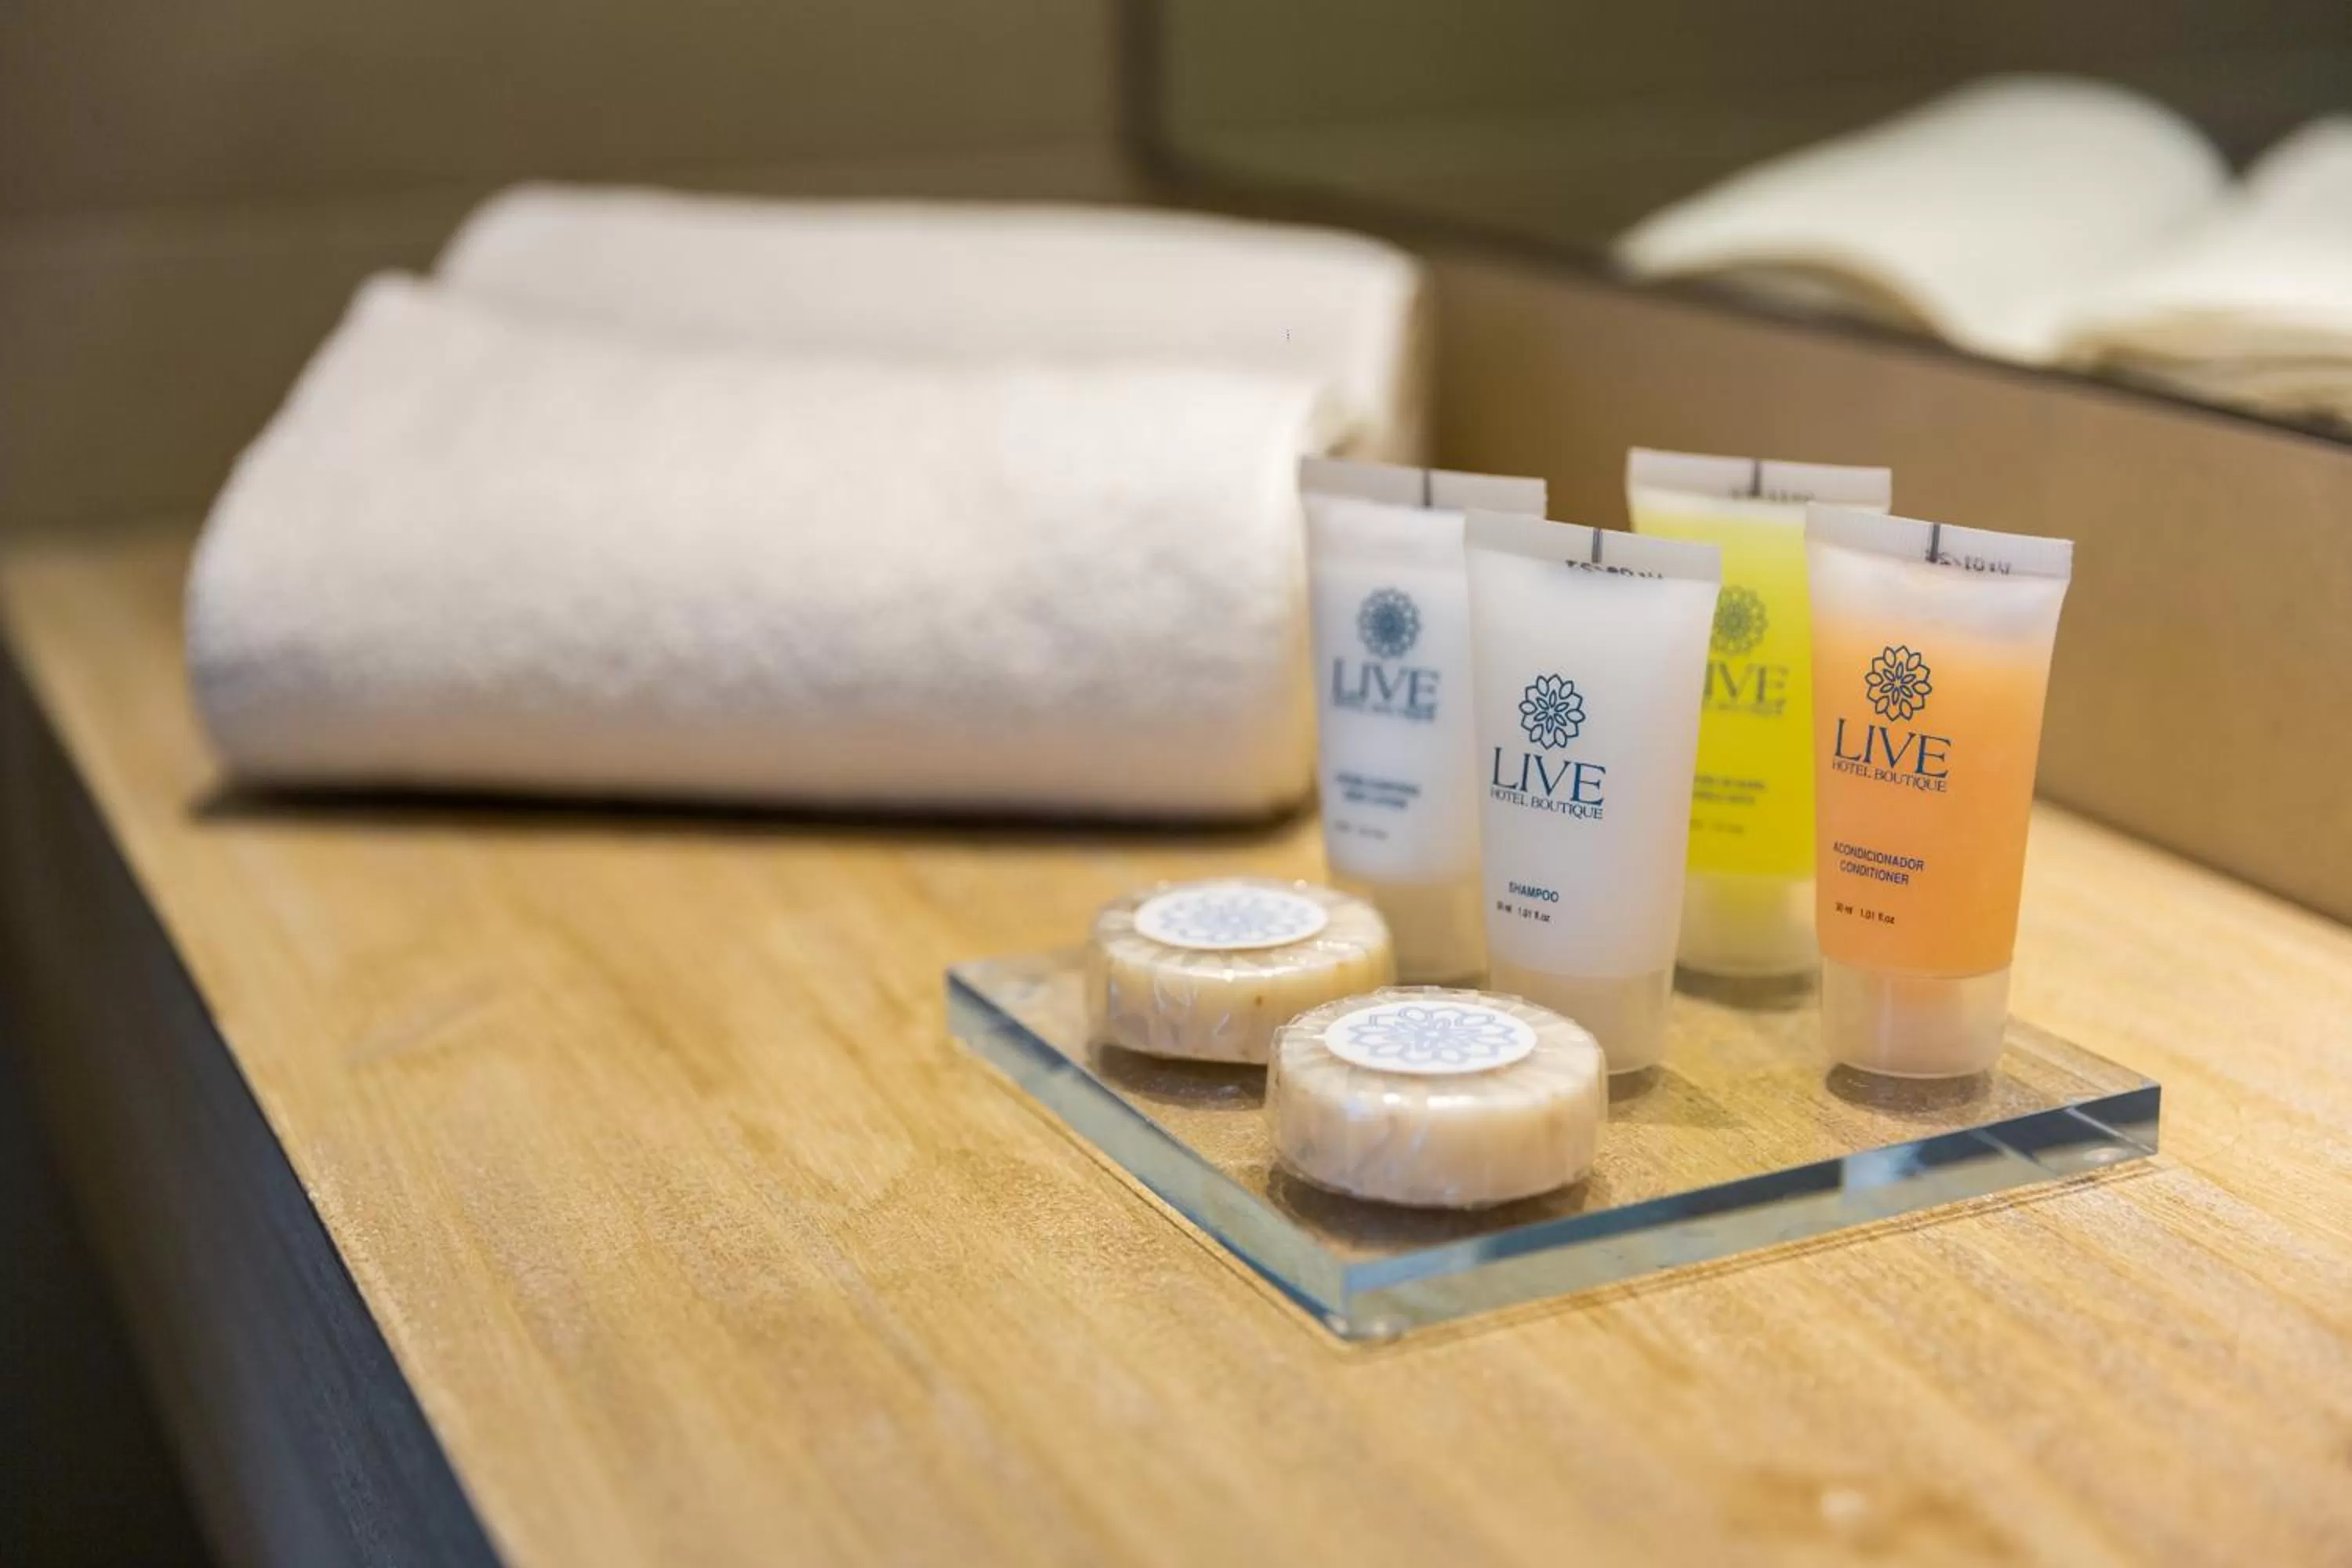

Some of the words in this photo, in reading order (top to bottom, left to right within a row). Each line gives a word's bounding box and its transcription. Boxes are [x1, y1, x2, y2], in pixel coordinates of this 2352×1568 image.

[1333, 656, 1441, 710] LIVE
[1703, 661, 1790, 707] IVE
[1835, 718, 1951, 779] LIVE
[1492, 746, 1606, 807] LIVE
[1832, 758, 1871, 779] HOTEL
[1875, 768, 1947, 793] BOUTIQUE
[1490, 786, 1528, 808] HOTEL
[1530, 795, 1603, 820] BOUTIQUE
[1833, 841, 1925, 872] ACONDICIONADOR
[1839, 859, 1909, 885] CONDITIONER
[1508, 880, 1559, 903] SHAMPOO
